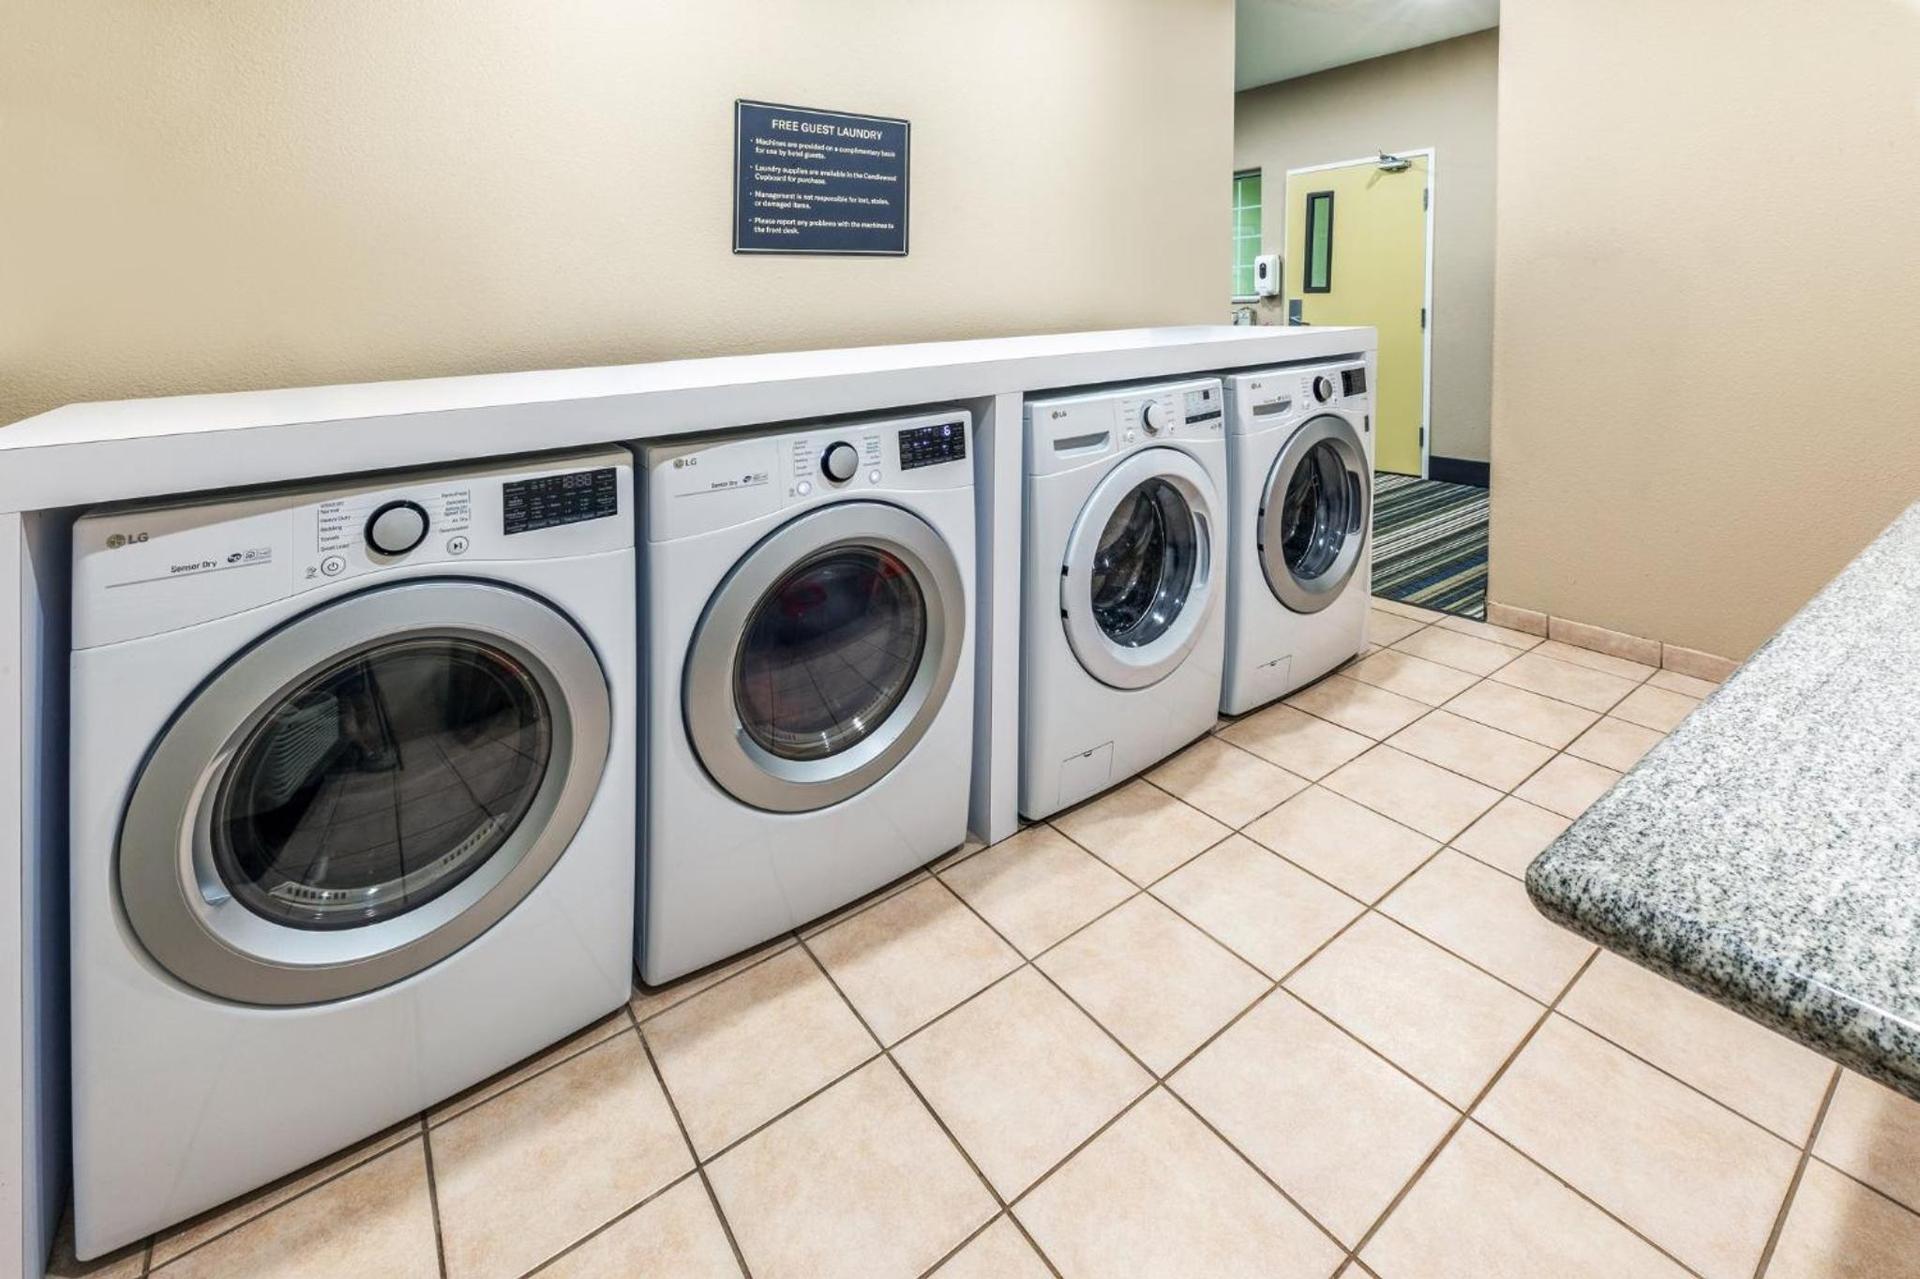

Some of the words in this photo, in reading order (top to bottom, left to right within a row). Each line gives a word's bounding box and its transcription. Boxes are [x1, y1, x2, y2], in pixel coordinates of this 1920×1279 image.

[772, 119, 799, 131] FREE
[800, 122, 835, 135] GUEST
[837, 127, 883, 140] LAUNDRY
[755, 138, 786, 147] Machines
[799, 143, 825, 151] provided
[839, 147, 880, 157] complimentary
[779, 149, 786, 157] by
[755, 164, 781, 173] Laundry
[782, 167, 808, 175] supplies
[864, 172, 897, 181] Candlewood
[755, 172, 786, 182] Cupboard
[754, 190, 795, 200] Management
[762, 200, 791, 209] damaged
[809, 219, 836, 227] problems
[685, 458, 697, 466] LG
[128, 532, 149, 545] LG
[171, 562, 200, 574] Sensor
[202, 560, 217, 570] Dry
